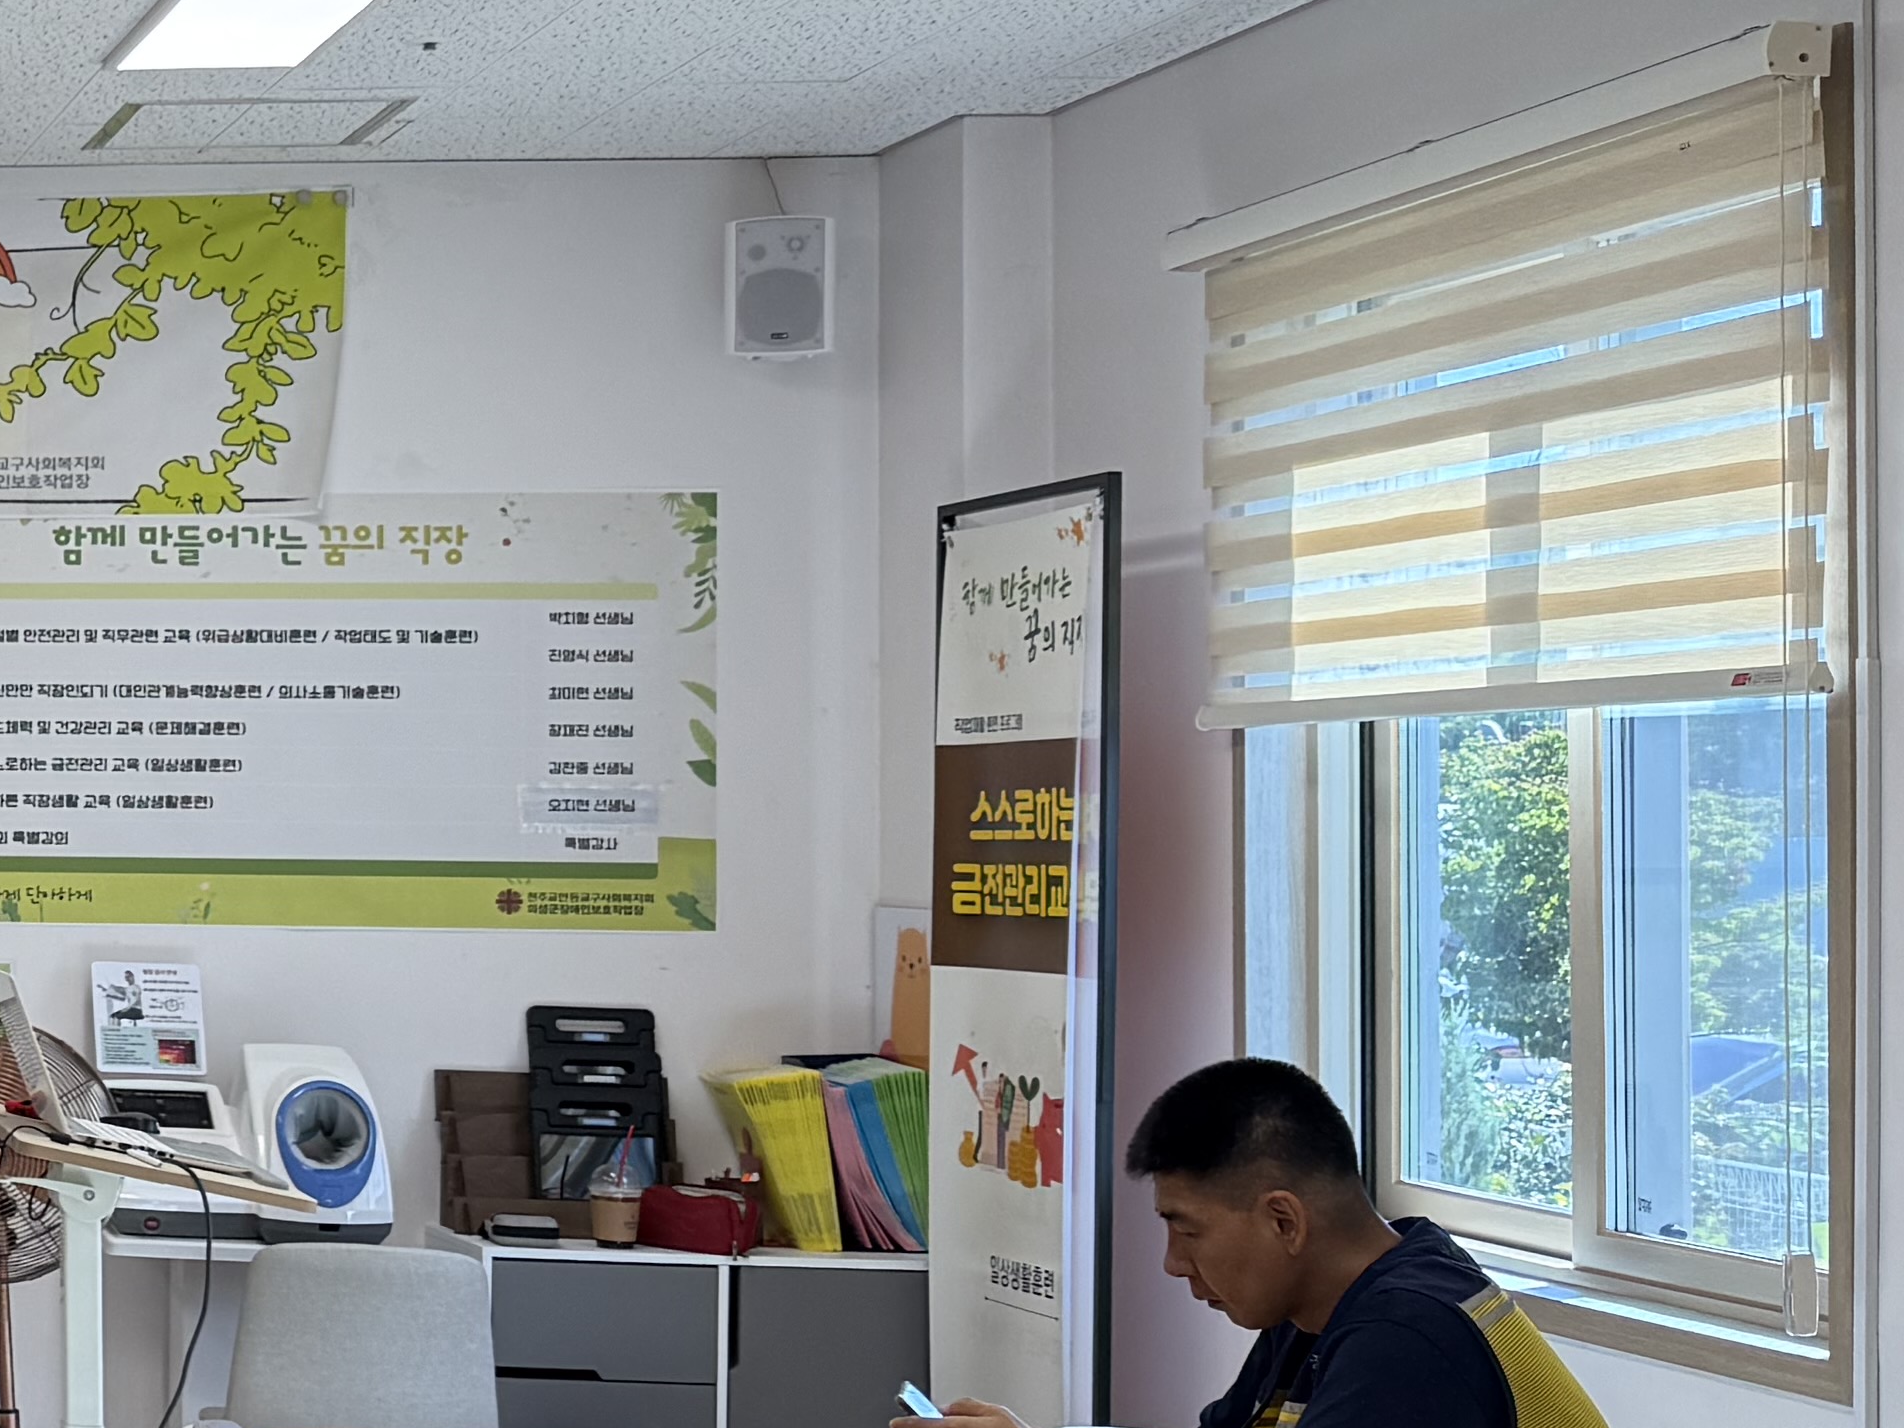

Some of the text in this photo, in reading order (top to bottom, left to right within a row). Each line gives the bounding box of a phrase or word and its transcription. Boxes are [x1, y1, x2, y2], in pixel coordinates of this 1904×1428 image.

[52, 524, 470, 567] 함께 만들어가는 꿈의 직장
[592, 611, 634, 626] 선생님
[23, 628, 81, 644] 안전관리
[101, 628, 160, 644] 직무관련
[162, 628, 191, 644] 교육
[592, 648, 634, 663] 선생님
[592, 686, 634, 701] 선생님
[54, 720, 112, 736] 건강관리
[115, 720, 144, 736] 교육
[592, 723, 634, 738] 선생님
[50, 757, 108, 772] 금전관리
[111, 757, 140, 773] 교육
[592, 761, 634, 775] 선생님
[82, 793, 112, 809] 교육
[593, 798, 636, 813] 선생님
[968, 786, 1076, 842] 스스로하는
[950, 862, 1092, 919] 금전관리교
[989, 1254, 1055, 1301] 일상생활훈련
